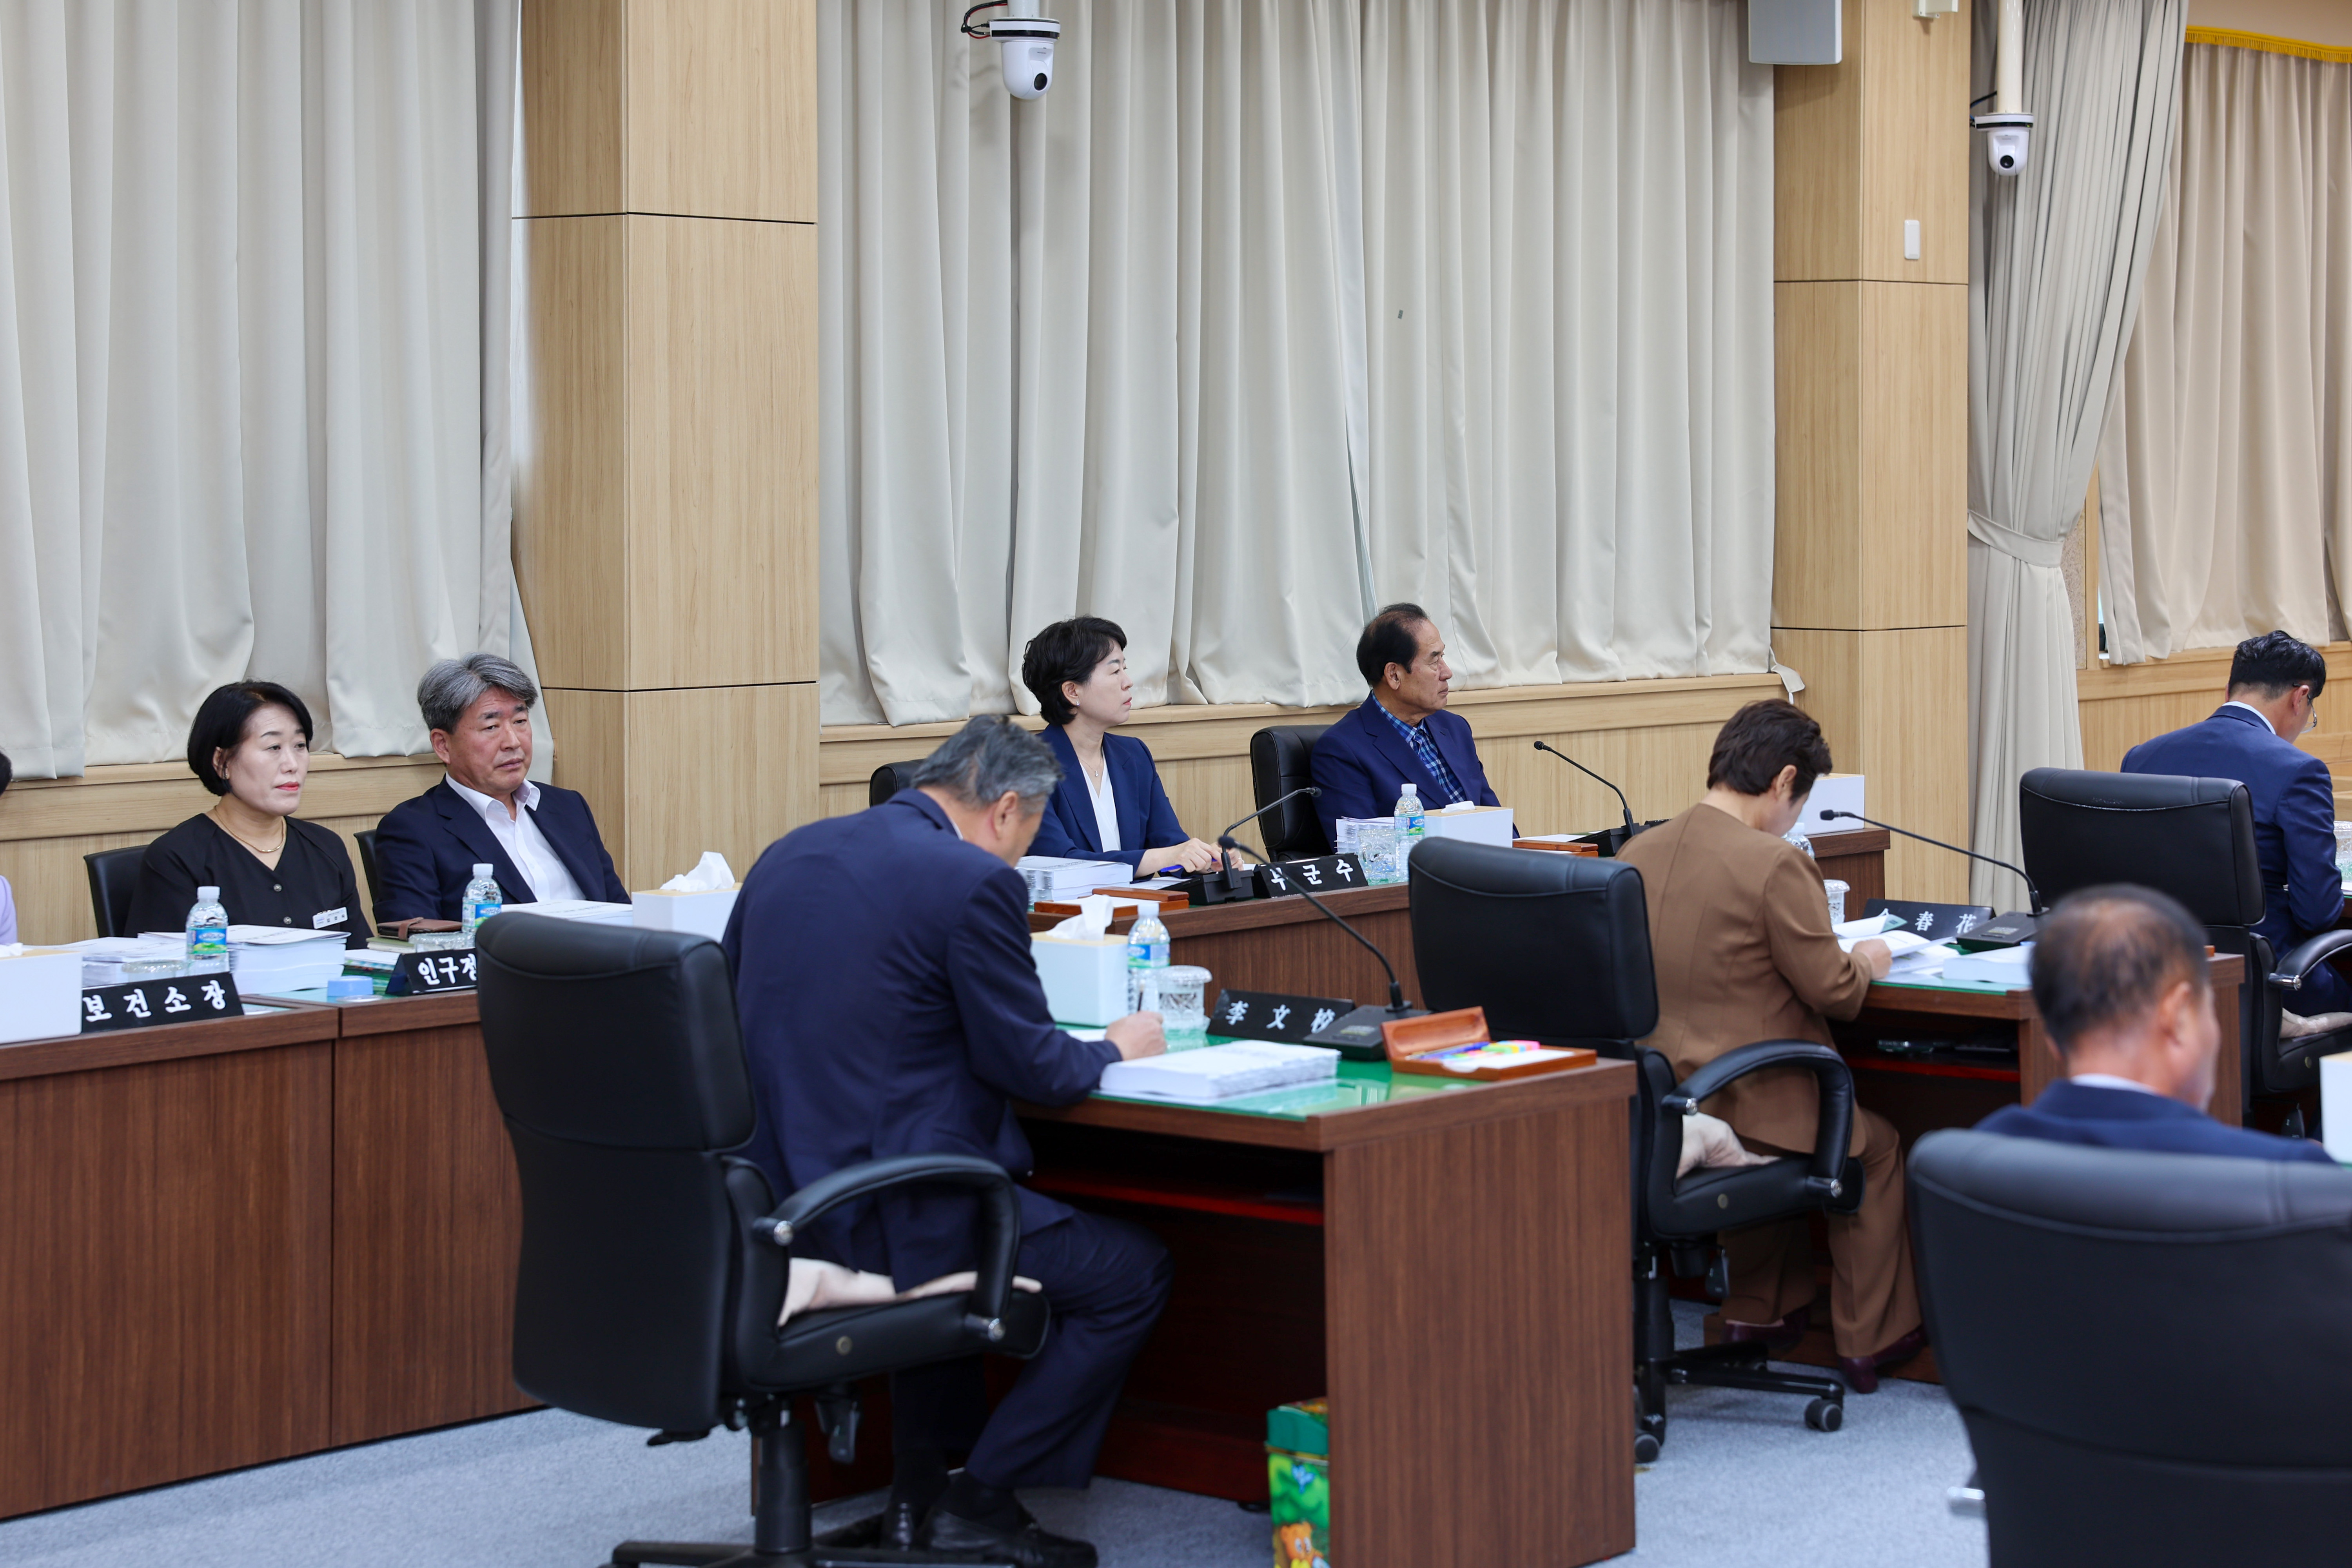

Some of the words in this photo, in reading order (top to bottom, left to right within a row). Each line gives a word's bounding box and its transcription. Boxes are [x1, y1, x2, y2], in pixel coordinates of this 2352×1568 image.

[1269, 859, 1353, 891] 부군수
[1876, 908, 1976, 934] 春花
[83, 980, 226, 1022] 보건소장
